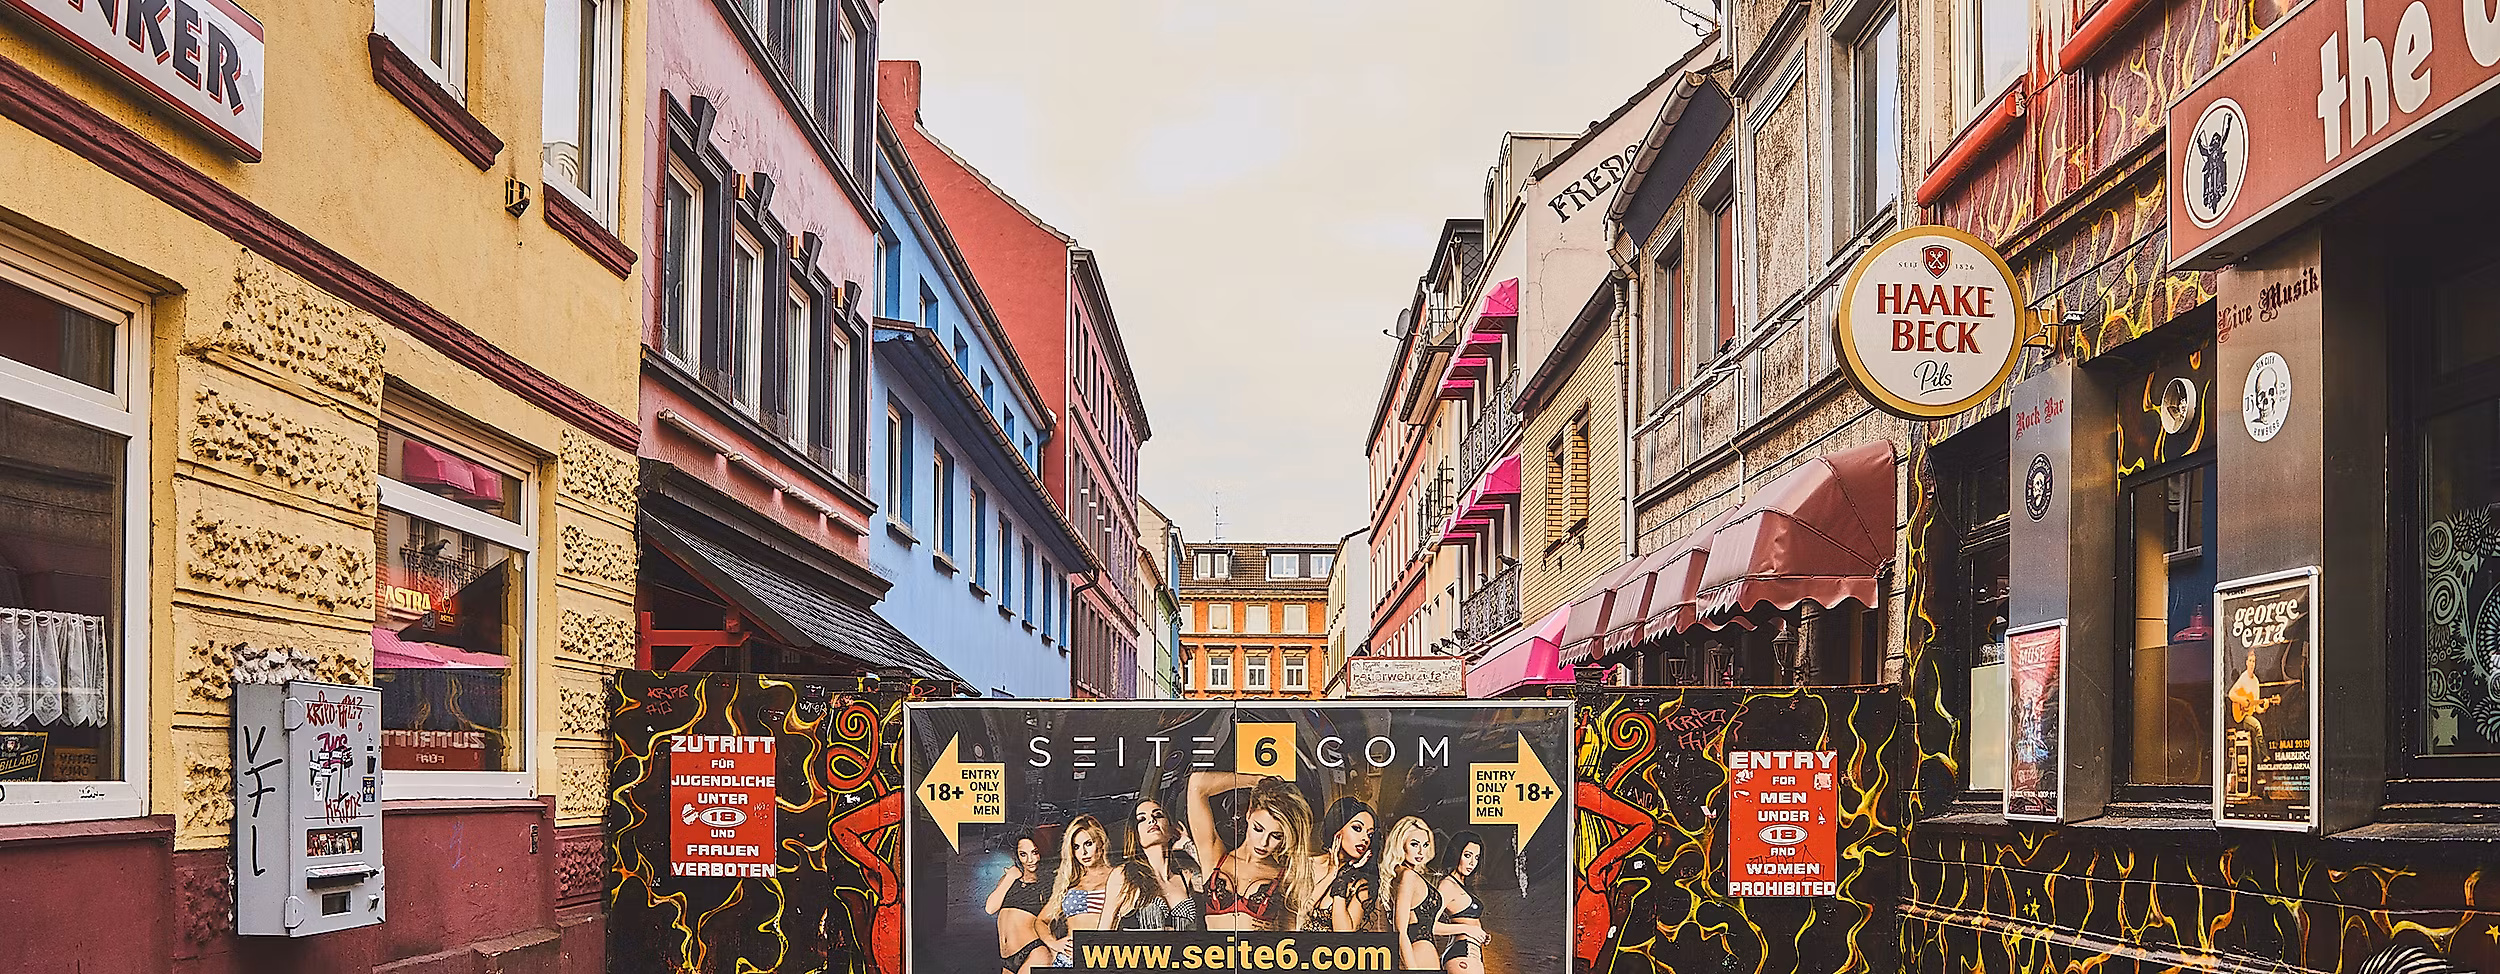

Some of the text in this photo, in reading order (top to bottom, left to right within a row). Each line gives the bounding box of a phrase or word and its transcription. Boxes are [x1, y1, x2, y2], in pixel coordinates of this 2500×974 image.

[2317, 0, 2433, 163] the
[1955, 263, 1975, 271] 1826
[1877, 284, 1996, 318] HAAKE
[2218, 267, 2319, 343] Live Musik
[1891, 320, 1983, 354] BECK
[1913, 359, 1953, 391] Pils
[2014, 396, 2065, 441] Rock Bar
[385, 585, 432, 611] ASTRA
[2232, 598, 2300, 637] george
[2241, 622, 2285, 648] ezra
[2019, 645, 2047, 665] MUSE
[671, 735, 776, 753] ZUTRITT
[2280, 739, 2294, 749] MAI
[2295, 739, 2311, 749] 2019
[1028, 735, 1450, 768] SEITE 6 COM
[0, 752, 39, 771] BILLARD
[711, 758, 735, 769] FÜR
[1731, 751, 1837, 769] ENTRY
[671, 774, 776, 787] JUGENDLICHE
[961, 769, 1000, 780] ENTRY
[1476, 770, 1516, 780] ENTRY
[1772, 776, 1796, 785] FOR
[926, 783, 964, 801] 18+
[969, 781, 1000, 792] ONLY
[1476, 782, 1508, 792] ONLY
[1515, 783, 1554, 802] 18+
[697, 792, 749, 804] UNTER
[976, 793, 1000, 803] FOR
[1476, 795, 1501, 805] FOR
[1760, 791, 1807, 804] MEN
[709, 811, 737, 822] 18
[973, 805, 1000, 815] MEN
[1476, 807, 1503, 817] MEN
[1757, 810, 1810, 822] UNDER
[710, 829, 736, 838] UND
[1769, 829, 1797, 840] 18
[686, 844, 760, 857] FRAUEN
[1770, 847, 1796, 856] AND
[671, 862, 775, 878] VERBOTEN
[1745, 863, 1820, 875] WOMEN
[1729, 881, 1836, 896] PROHIBITED
[1081, 937, 1392, 970] www.seite6.com
